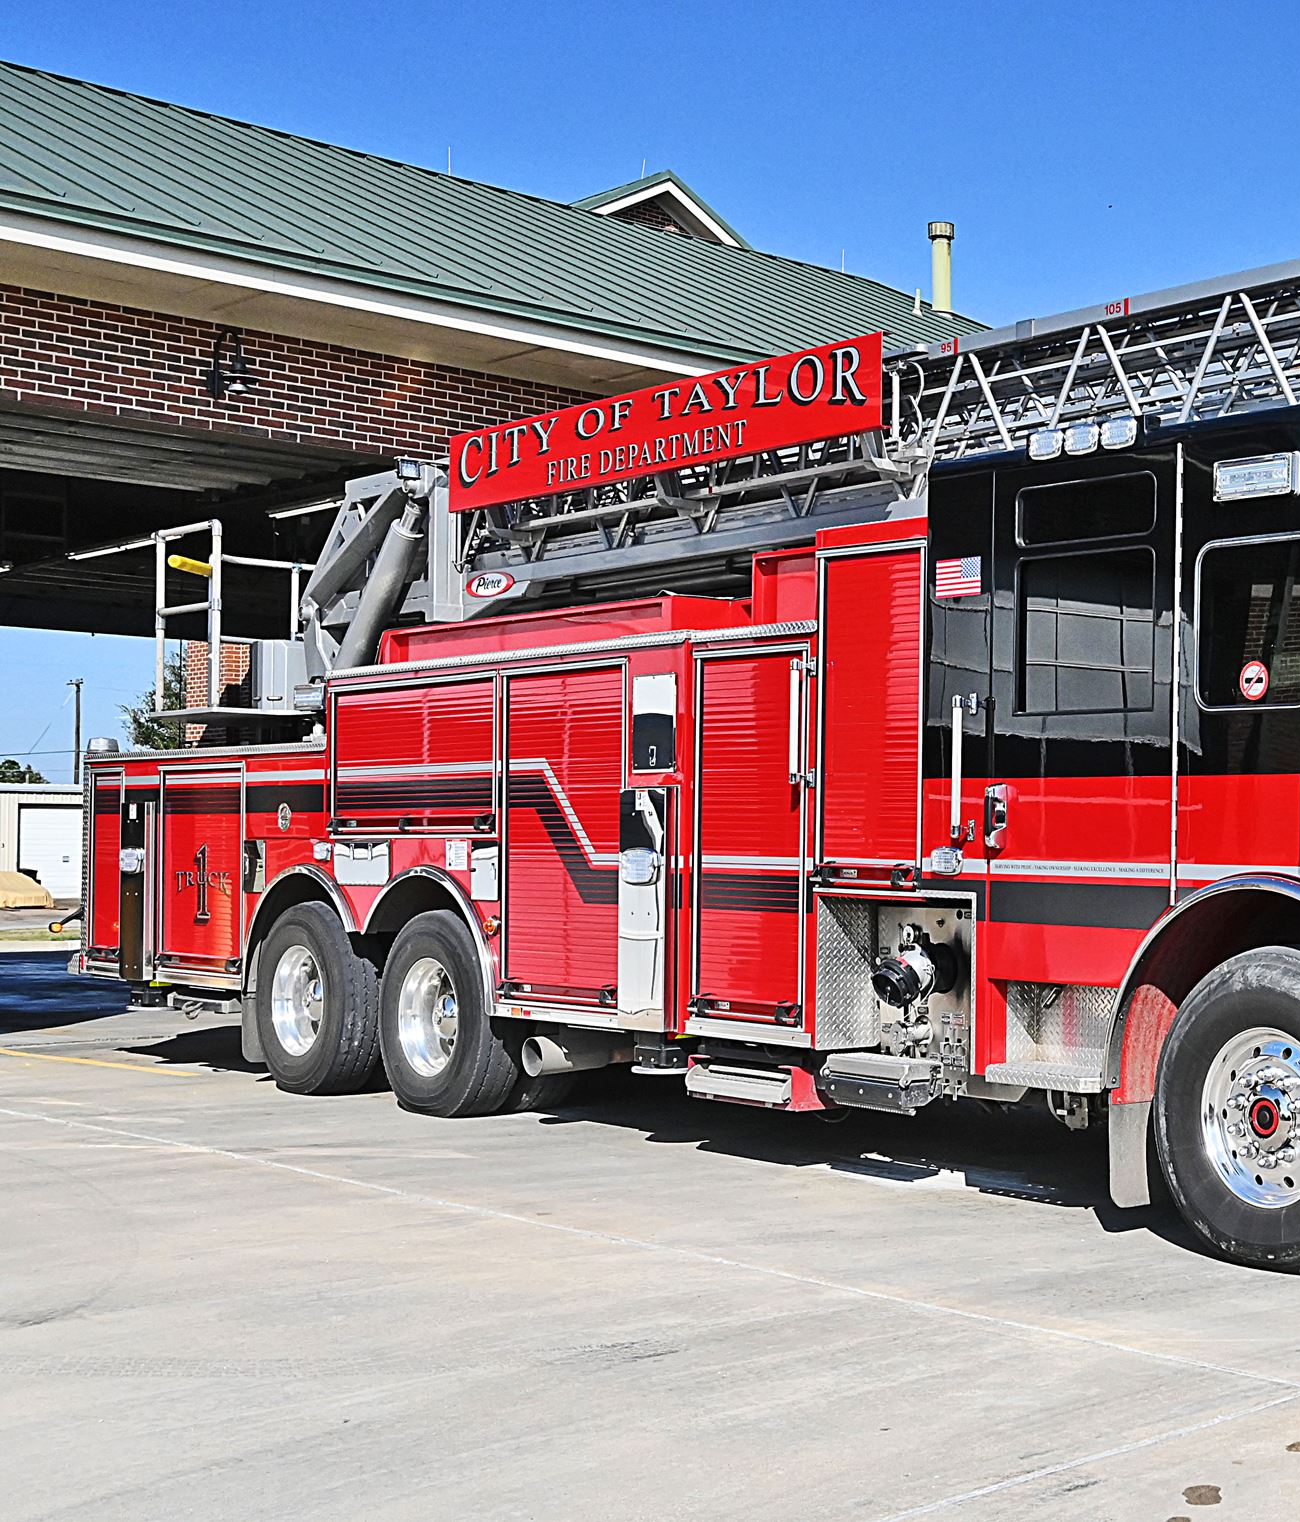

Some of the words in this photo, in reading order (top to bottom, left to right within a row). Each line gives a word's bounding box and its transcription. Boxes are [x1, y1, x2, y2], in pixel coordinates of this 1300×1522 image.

[1103, 302, 1122, 316] 105
[940, 342, 952, 353] 95
[458, 416, 559, 489] CITY
[575, 399, 634, 440] OF
[651, 345, 867, 421] TAYLOR
[546, 453, 591, 486] FIRE
[599, 419, 747, 475] DEPARTMENT
[475, 577, 502, 592] Pierce
[175, 871, 232, 898] TRUCK
[194, 842, 211, 926] 1
